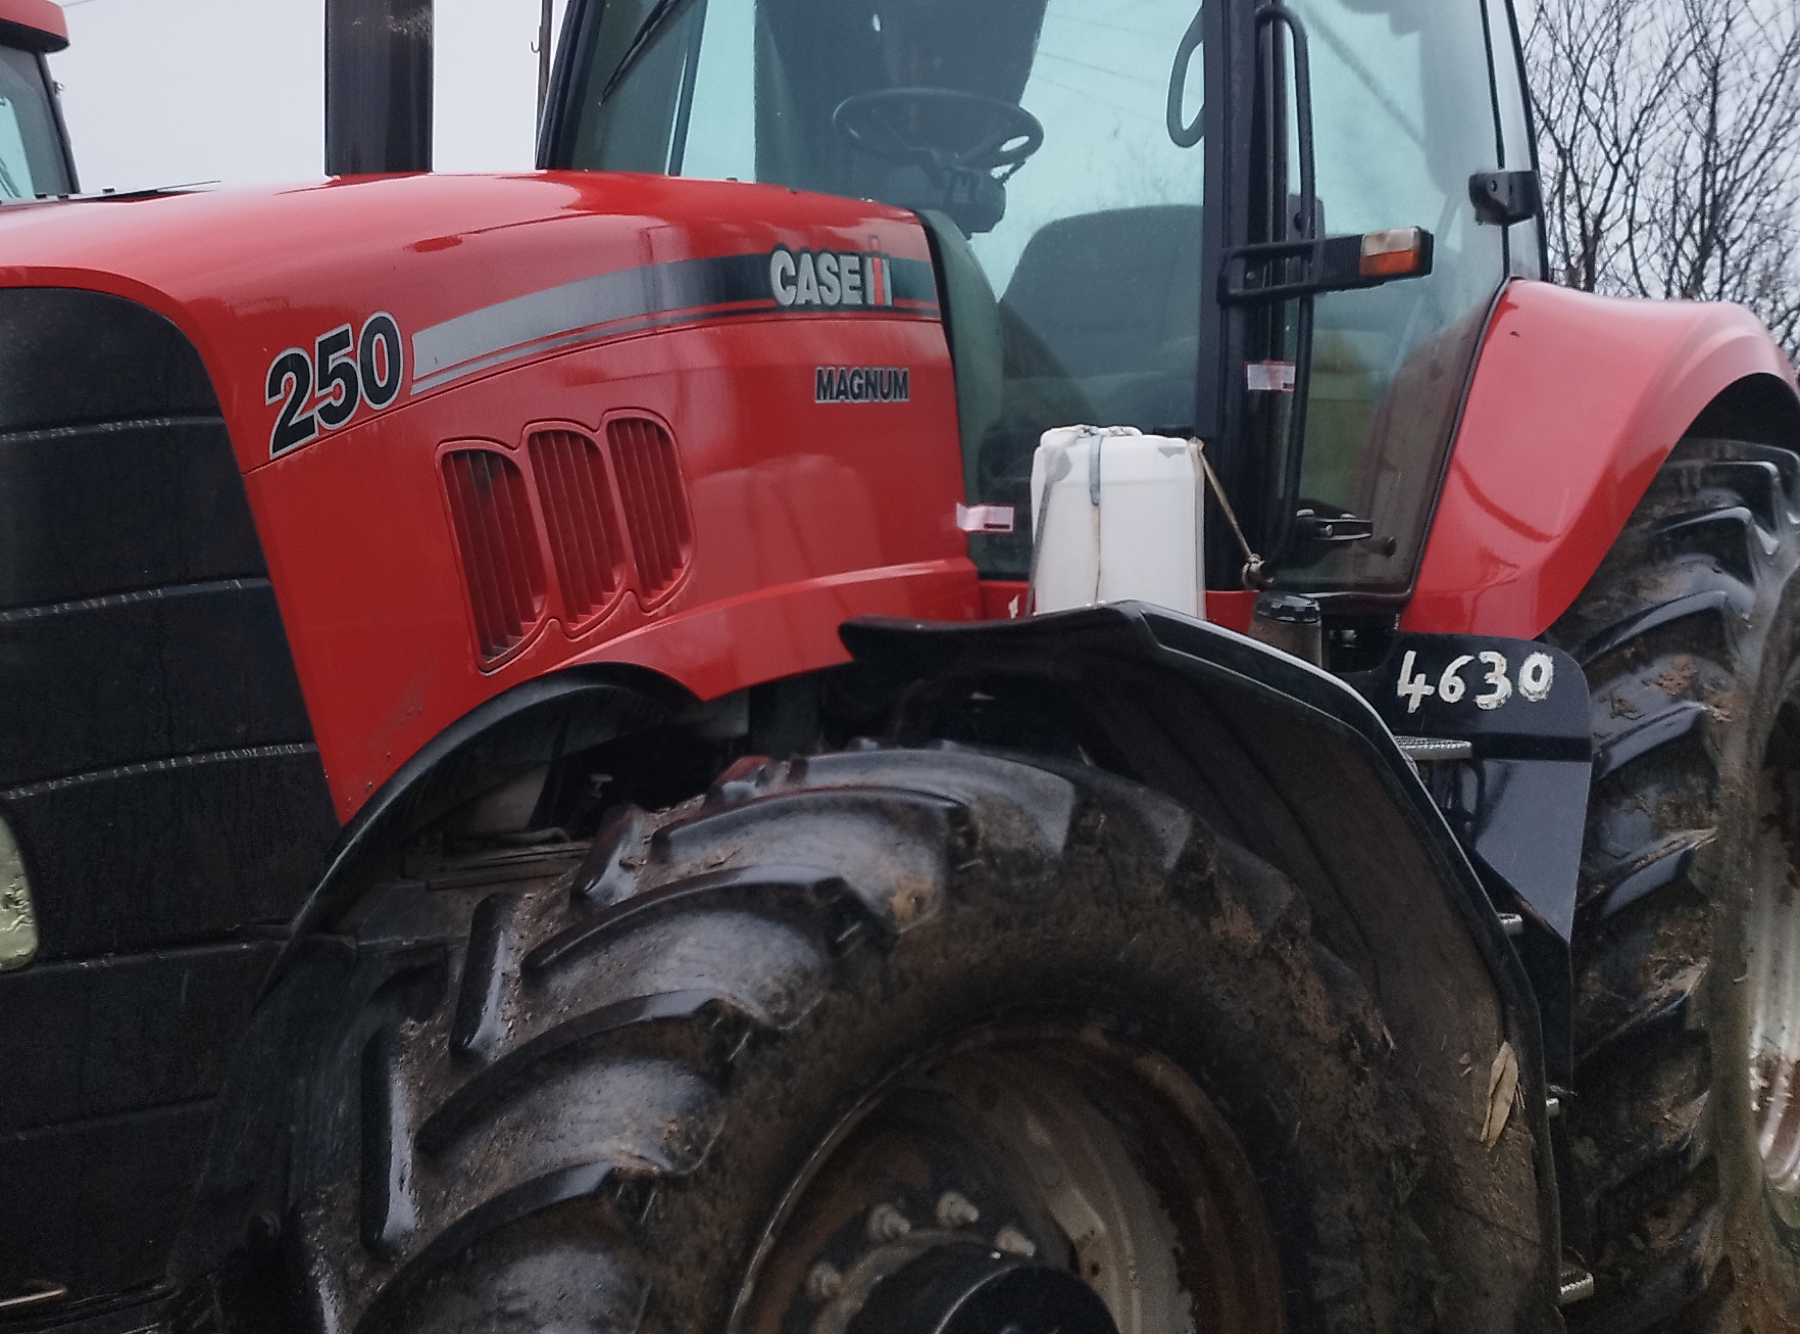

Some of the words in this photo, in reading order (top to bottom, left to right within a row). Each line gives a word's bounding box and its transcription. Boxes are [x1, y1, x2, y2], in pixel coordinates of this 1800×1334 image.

[770, 249, 863, 306] CASE
[265, 311, 403, 459] 250
[815, 366, 909, 402] MAGNUM
[1397, 650, 1554, 713] 4630
